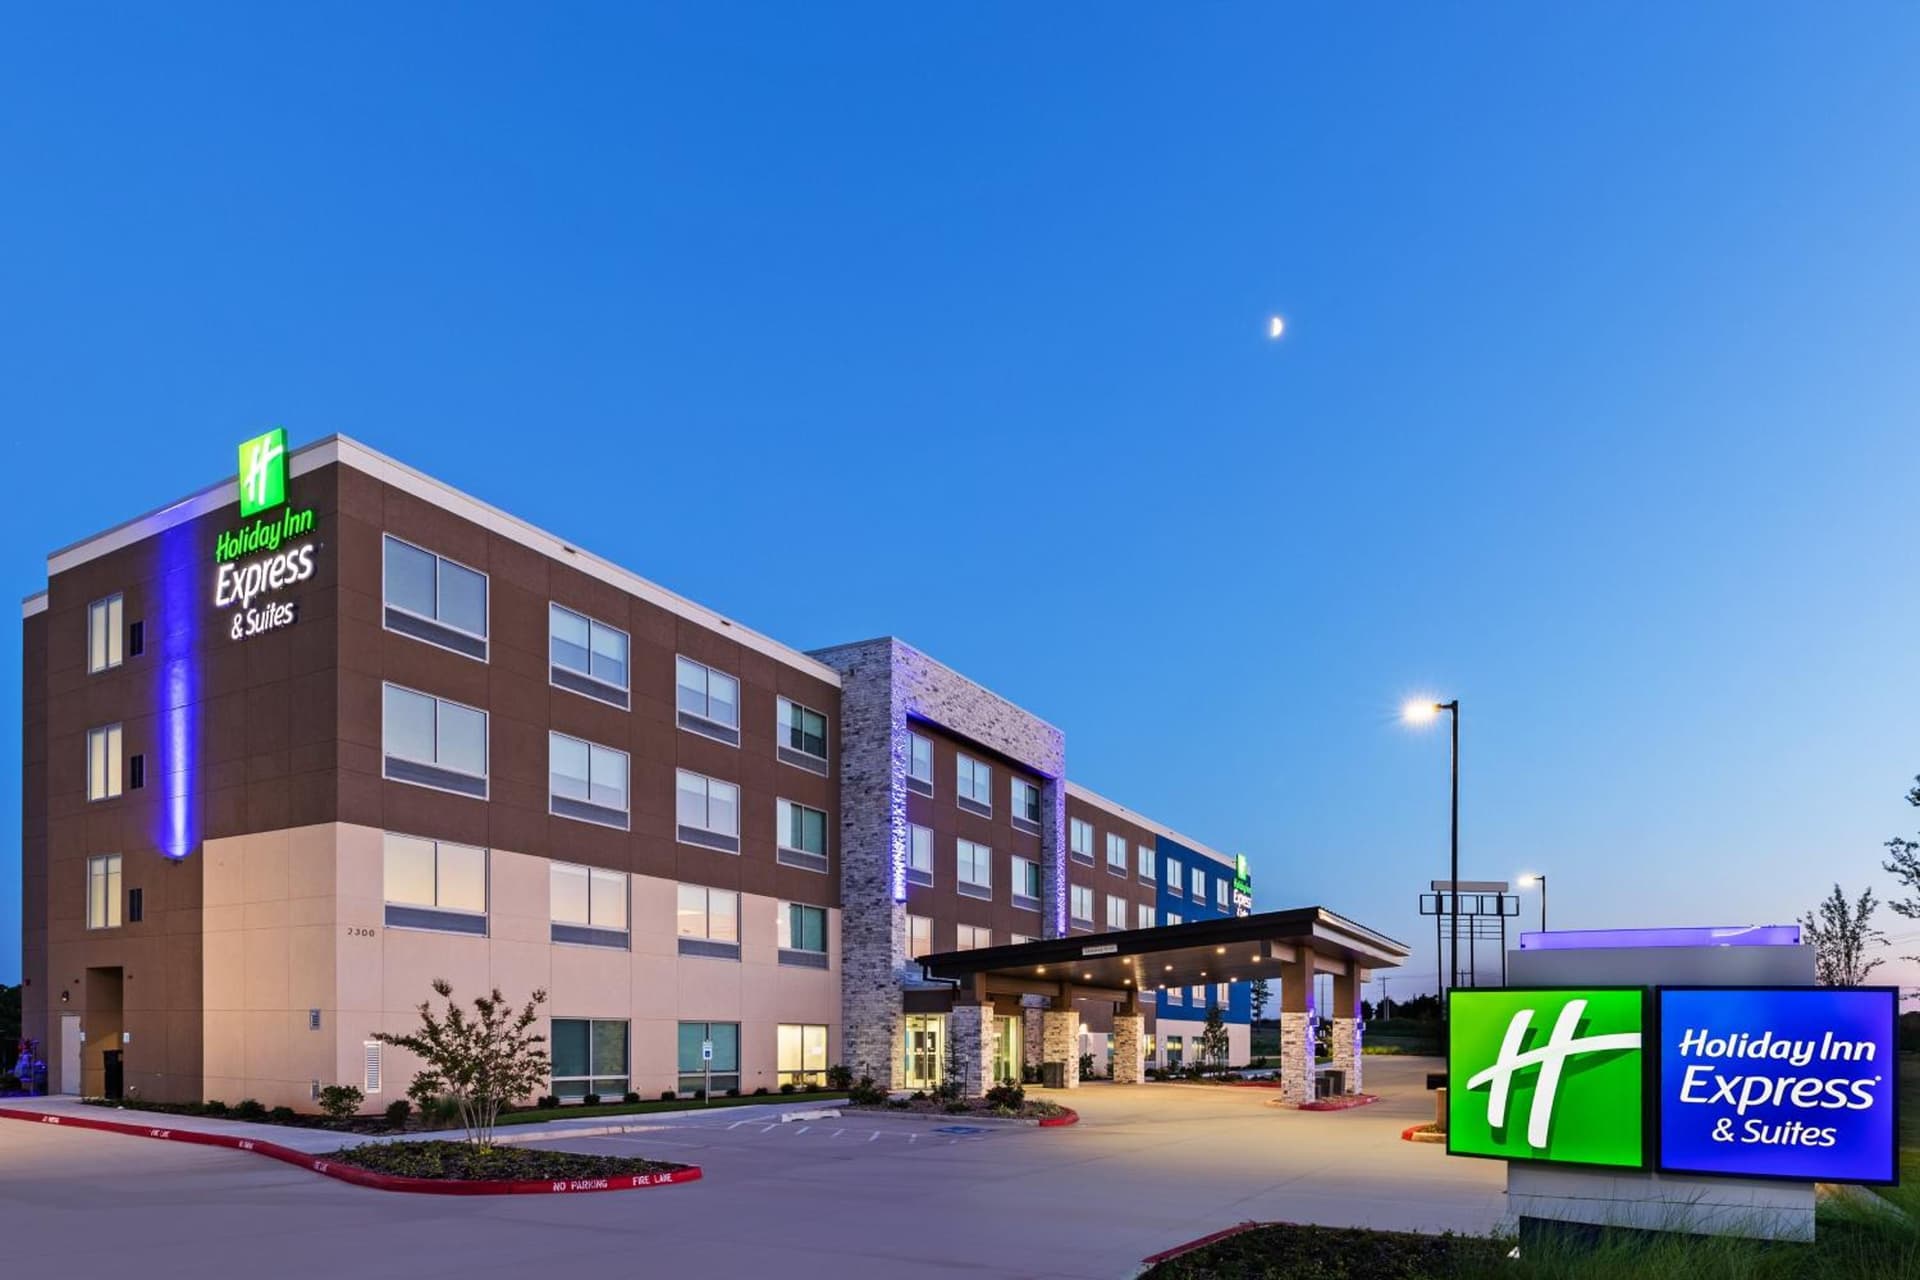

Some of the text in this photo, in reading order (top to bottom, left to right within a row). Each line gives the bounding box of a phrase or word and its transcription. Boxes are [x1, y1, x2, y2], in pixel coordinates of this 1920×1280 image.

[215, 507, 313, 563] Holiday Inn
[215, 544, 315, 609] Express
[230, 602, 294, 640] & Suites
[347, 927, 375, 937] 2300
[1678, 1028, 1877, 1067] Holiday Inn
[1679, 1064, 1880, 1116] Express
[1711, 1117, 1837, 1147] & Suites
[553, 1173, 673, 1192] NO PARKING FIRE LANE
